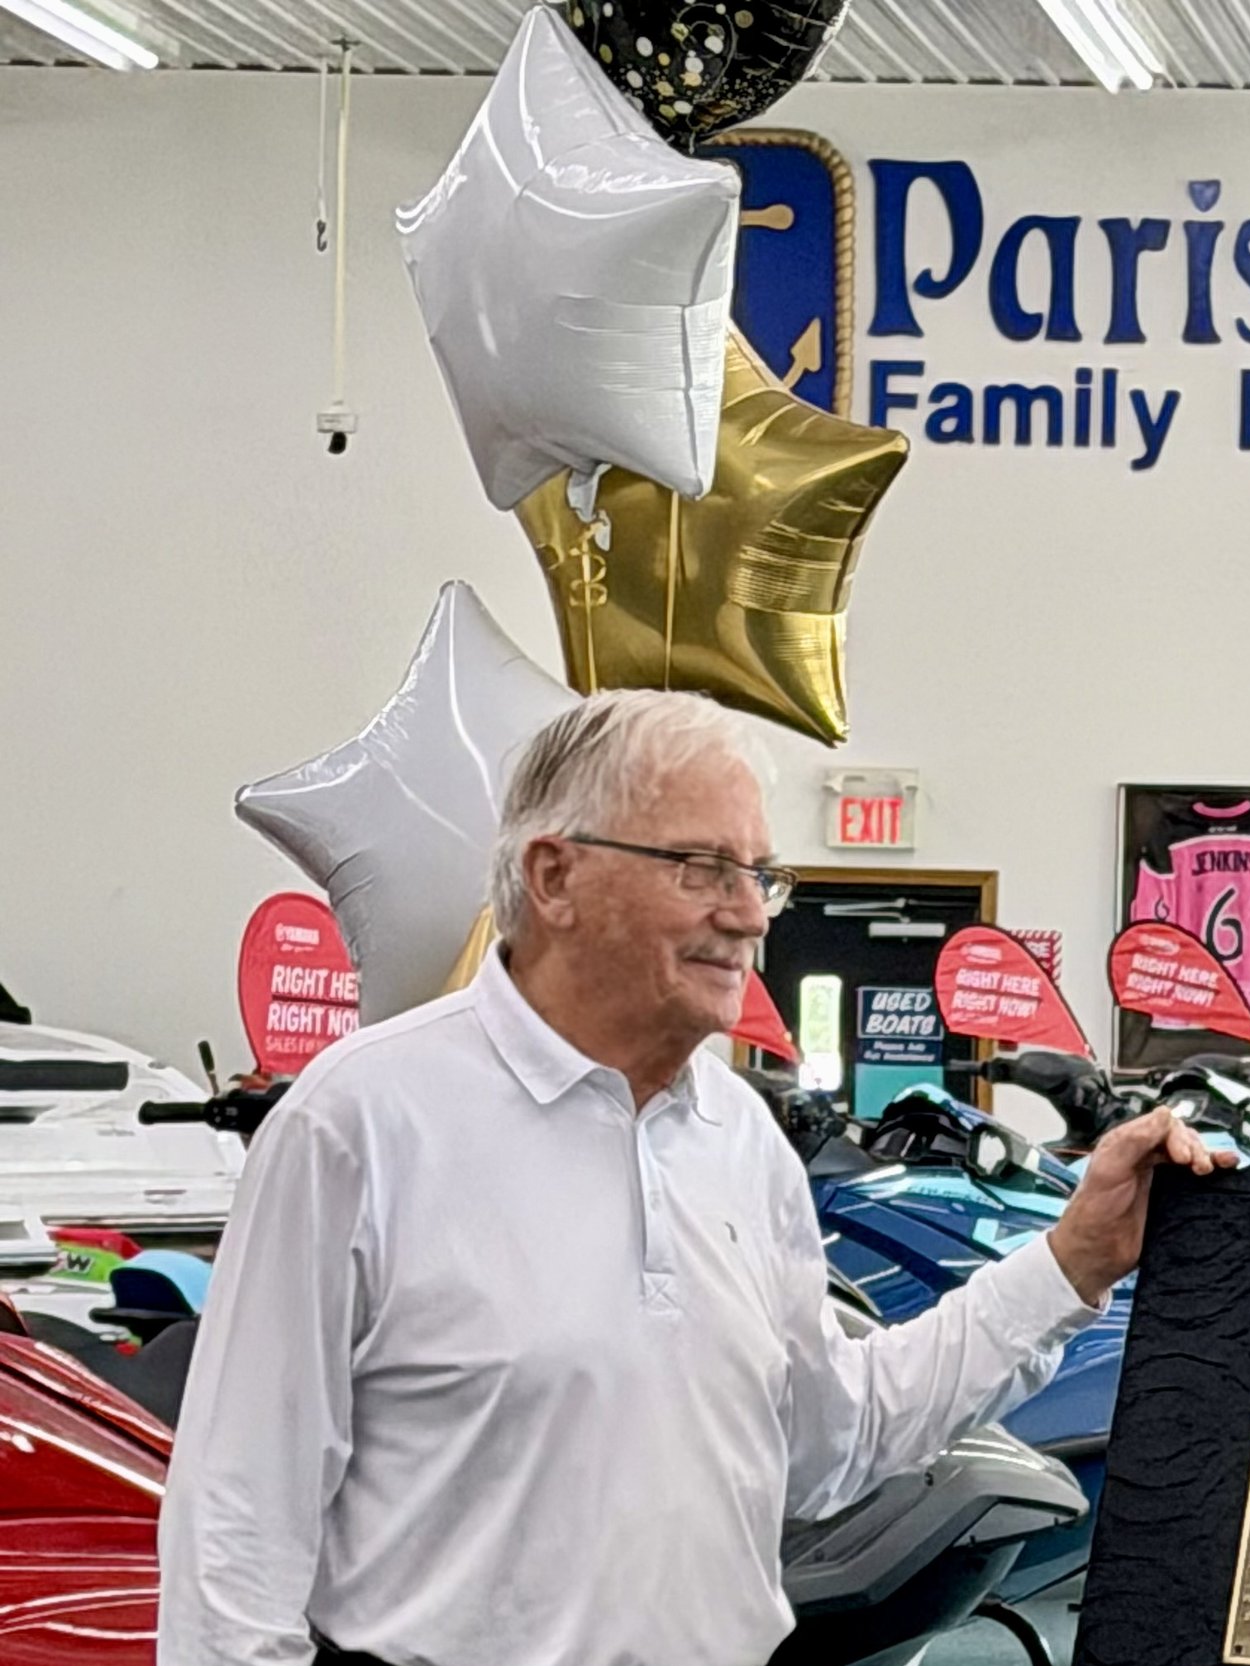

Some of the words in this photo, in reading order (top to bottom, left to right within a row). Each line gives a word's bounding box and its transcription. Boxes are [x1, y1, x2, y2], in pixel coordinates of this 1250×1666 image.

[869, 360, 1181, 471] Family
[841, 796, 903, 844] EXIT
[1155, 896, 1169, 920] 6
[1205, 885, 1244, 963] 6
[271, 965, 329, 998] RIGHT
[956, 968, 999, 990] RIGHT
[1000, 974, 1040, 997] HERE
[1126, 972, 1174, 996] RIGHT
[1132, 954, 1178, 978] RIGHT
[1179, 965, 1218, 989] HERE
[871, 992, 932, 1012] USED
[952, 990, 997, 1012] RIGHT
[267, 1003, 325, 1035] RIGHT
[865, 1014, 936, 1035] BOATS
